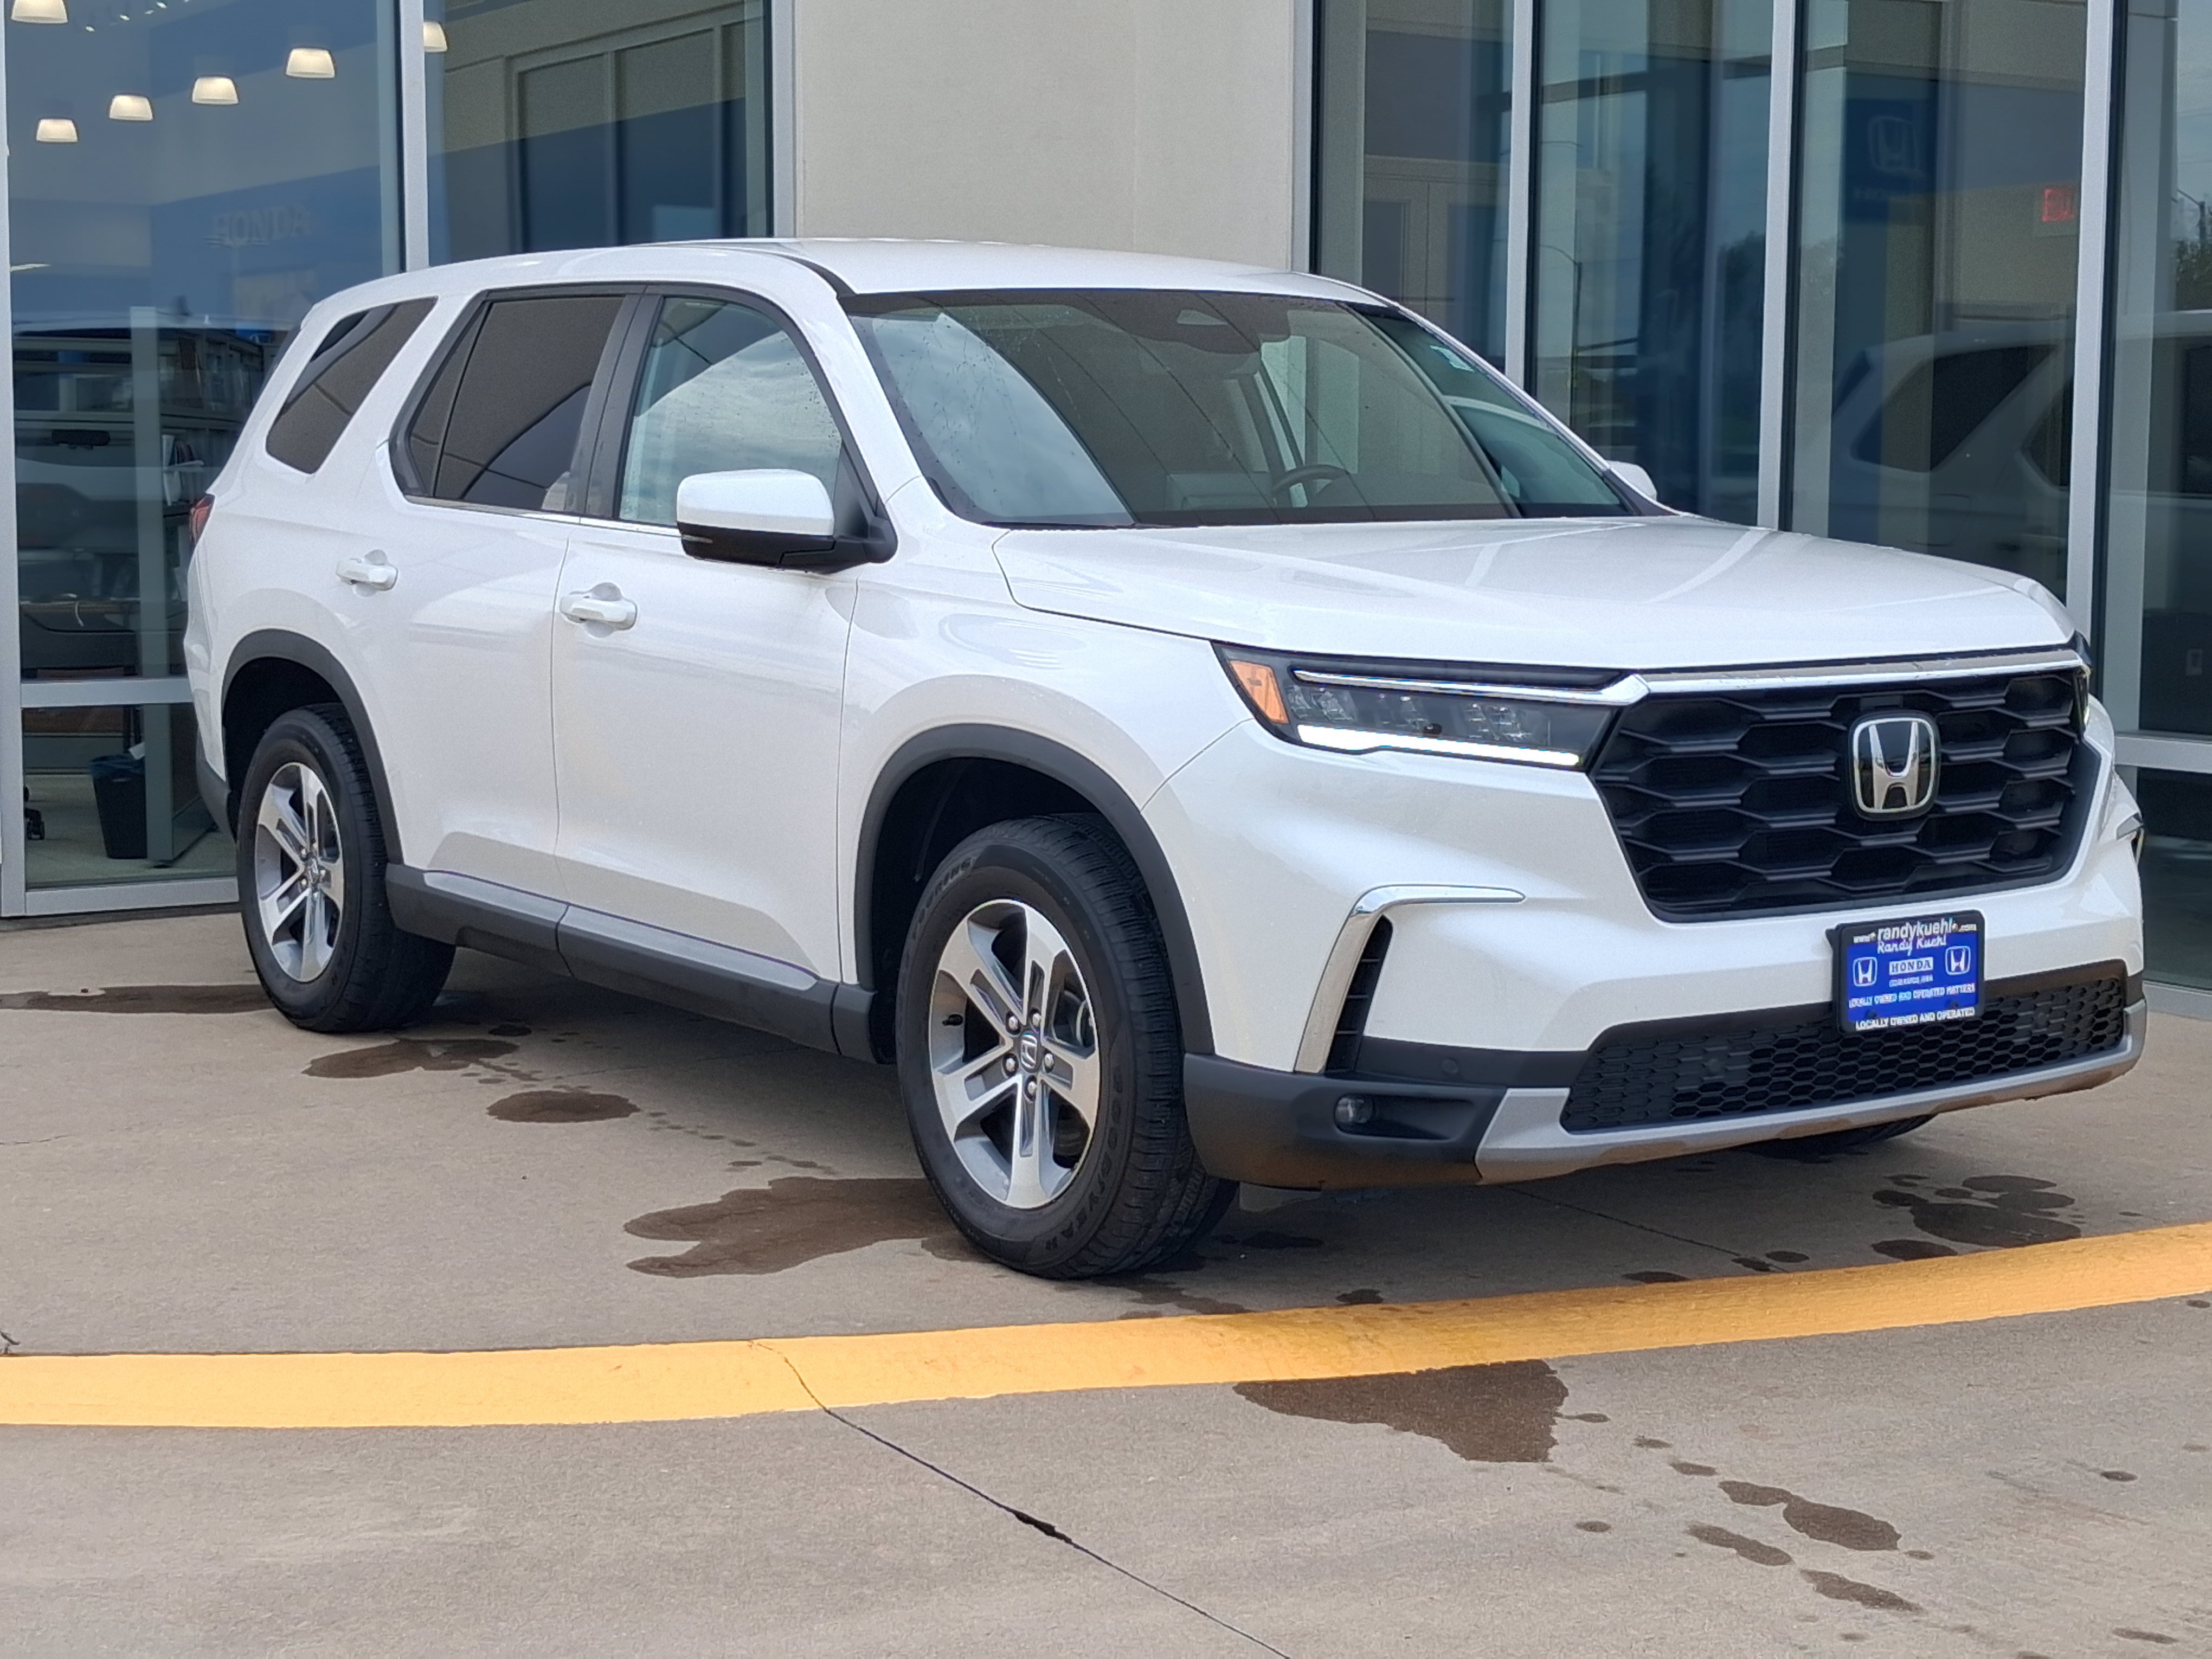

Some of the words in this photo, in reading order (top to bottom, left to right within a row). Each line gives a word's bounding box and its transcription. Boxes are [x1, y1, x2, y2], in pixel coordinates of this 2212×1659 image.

[1877, 939, 1912, 956] Randy
[1891, 960, 1931, 973] HONDA
[1855, 1018, 1889, 1031] LOCALLY
[1891, 1014, 1918, 1026] OWNED
[1920, 1012, 1935, 1024] AND
[1937, 1007, 1975, 1021] OPERATED
